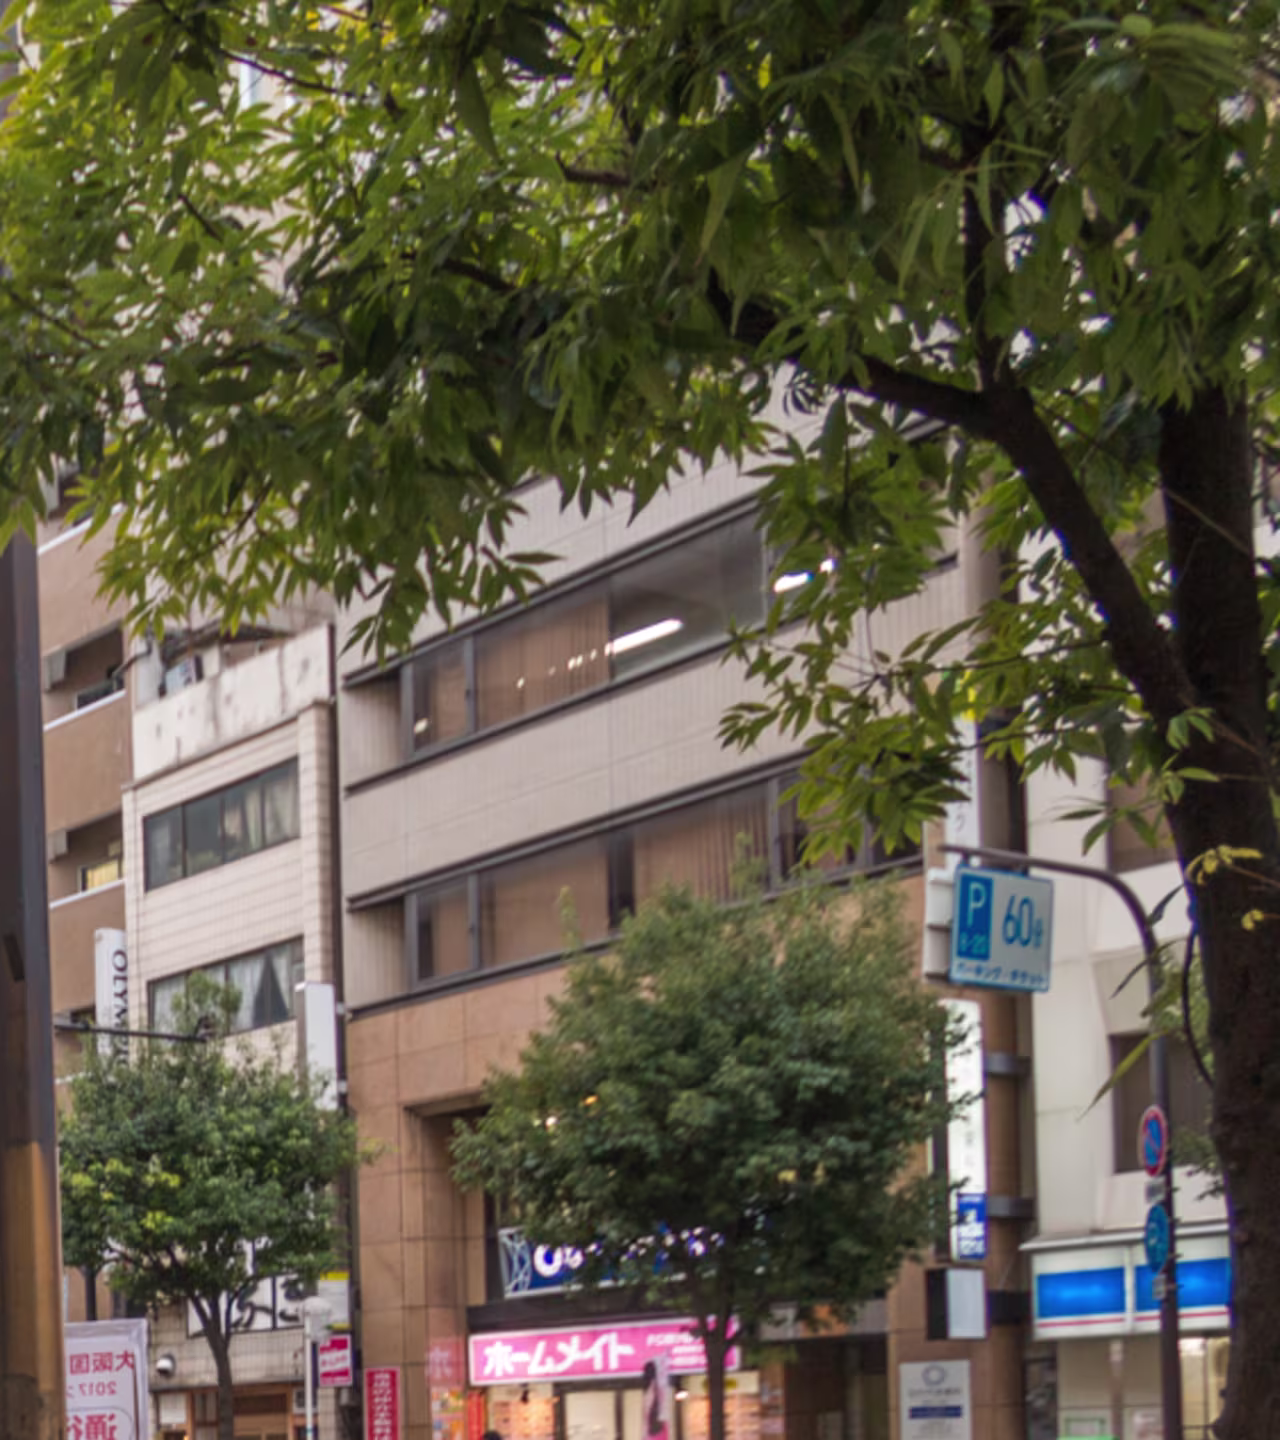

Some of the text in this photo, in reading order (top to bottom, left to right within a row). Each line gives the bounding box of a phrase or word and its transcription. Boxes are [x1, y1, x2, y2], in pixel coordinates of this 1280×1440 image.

[967, 881, 986, 928] P
[484, 1332, 635, 1377] ホームメイト
